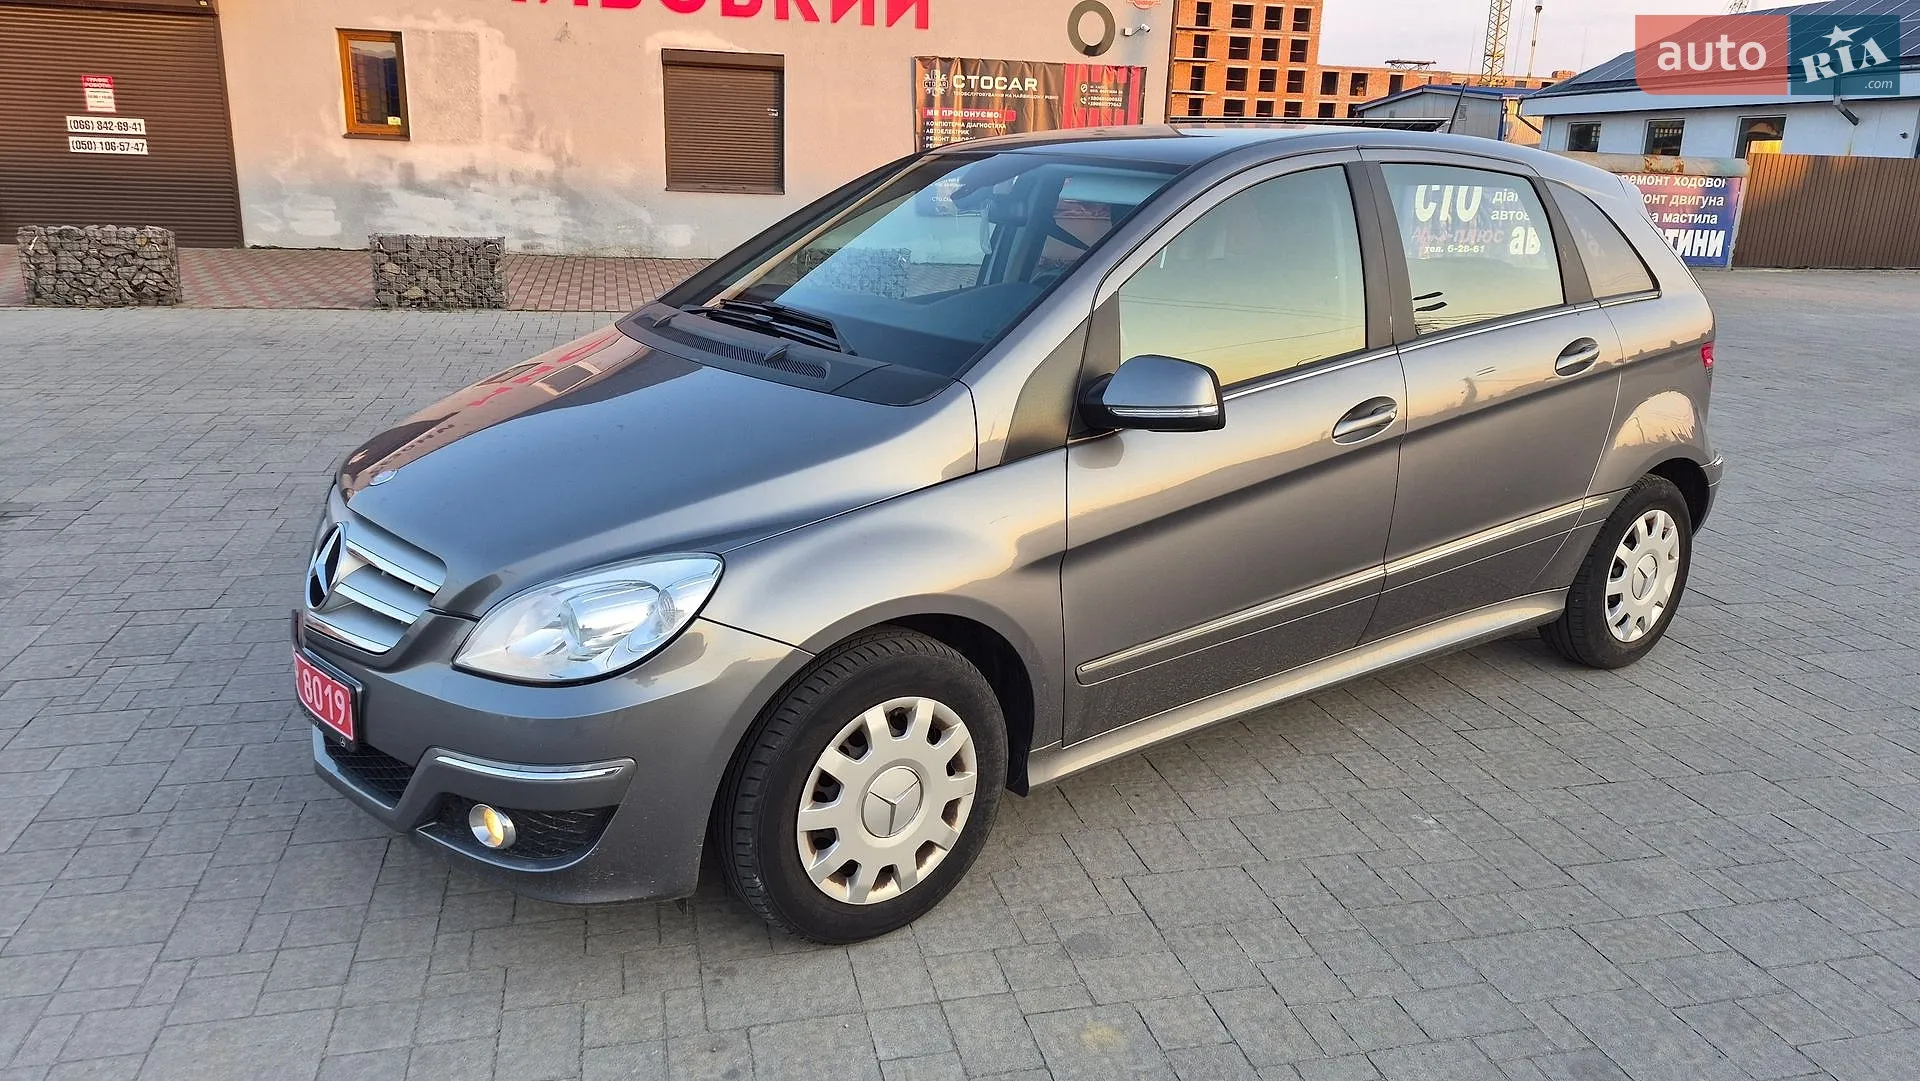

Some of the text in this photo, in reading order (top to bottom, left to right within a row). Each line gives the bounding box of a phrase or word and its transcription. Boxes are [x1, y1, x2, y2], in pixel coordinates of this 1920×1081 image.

[952, 74, 1038, 92] CTOCAR
[96, 120, 142, 132] 842-69-41
[71, 139, 145, 152] (050) 106-57-47
[1668, 194, 1725, 208] двигуна
[1662, 212, 1718, 225] мастила
[1660, 227, 1726, 258] ТИНИ
[302, 668, 346, 726] 8019
